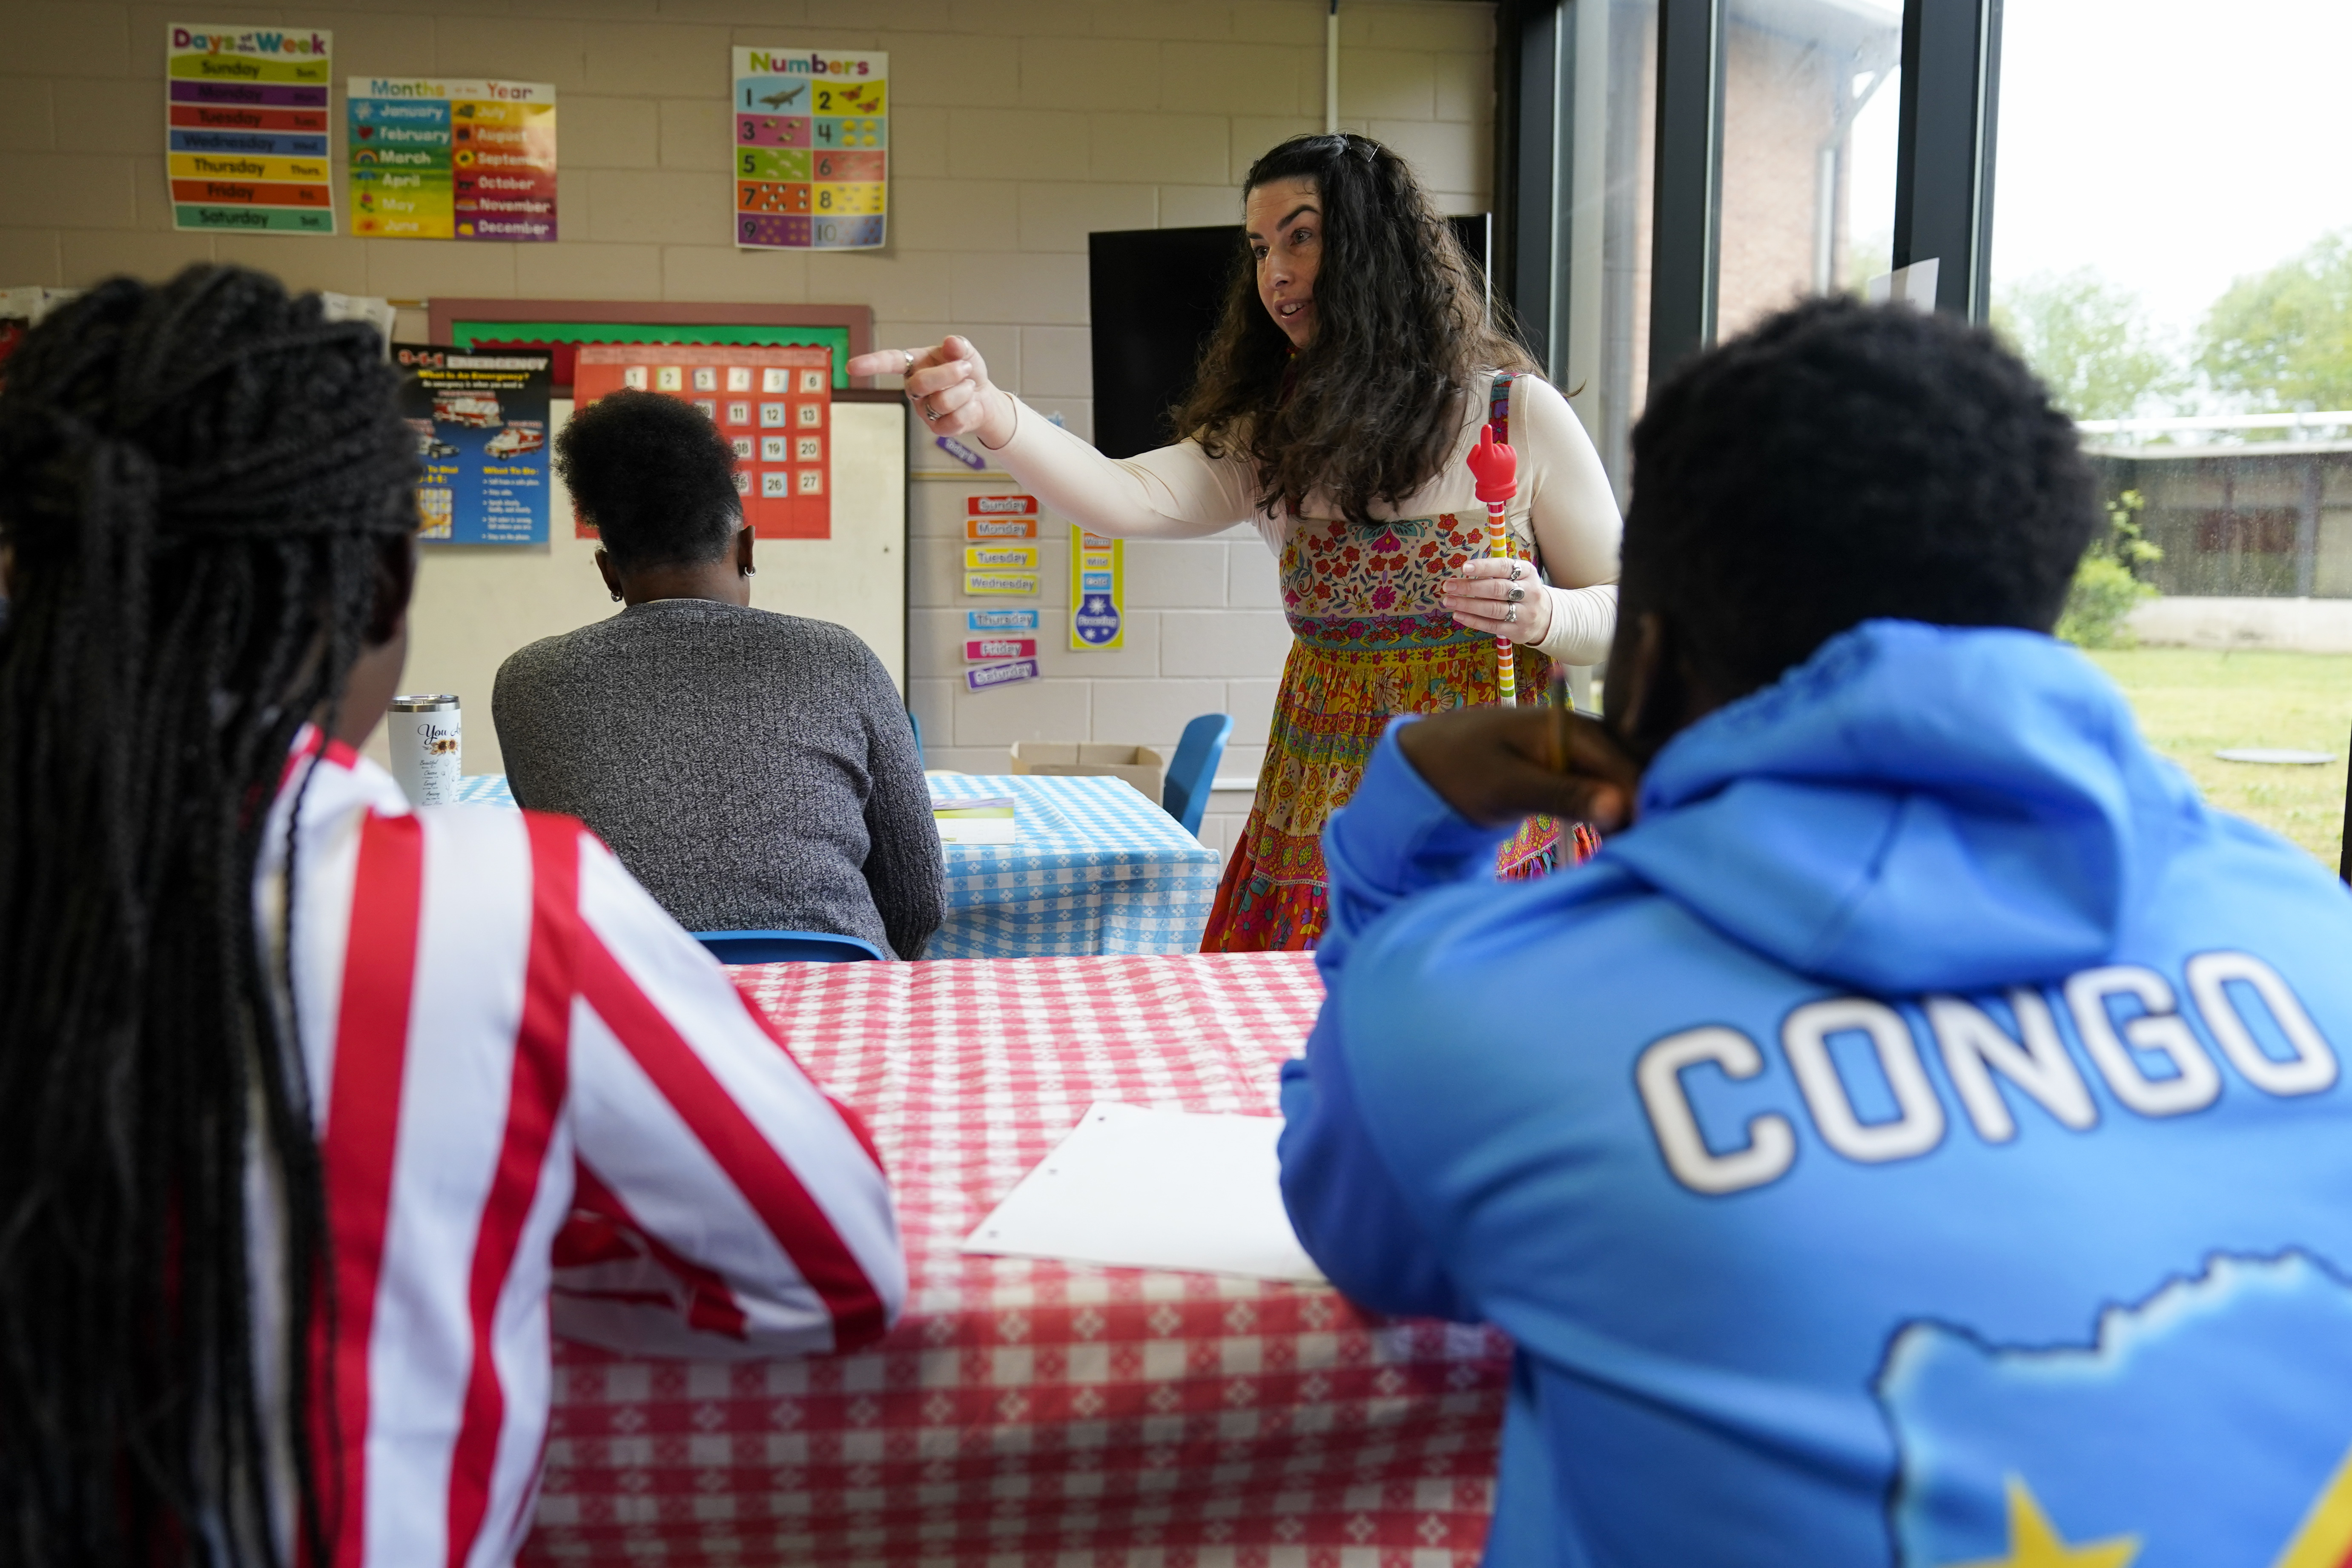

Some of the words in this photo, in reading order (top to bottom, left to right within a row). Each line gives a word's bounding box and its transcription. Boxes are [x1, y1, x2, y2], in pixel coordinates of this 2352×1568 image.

[173, 28, 235, 55] Days
[256, 32, 326, 55] Week
[201, 59, 261, 78] Sunday
[750, 52, 869, 75] Numbers
[371, 80, 445, 97] Months
[487, 83, 533, 99] Year
[746, 87, 751, 107] 1
[818, 91, 831, 110] 2
[199, 109, 262, 127] Tuesday
[381, 105, 443, 122] January
[380, 129, 450, 145] February
[743, 121, 755, 140] 3
[818, 124, 832, 143] 4
[379, 150, 431, 164] March
[743, 155, 755, 174] 5
[194, 158, 266, 178] Thursday
[819, 158, 832, 176] 6
[478, 175, 536, 190] October
[207, 183, 255, 202] Friday
[743, 188, 756, 206] 7
[820, 190, 832, 209] 8
[479, 198, 551, 213] November
[200, 209, 270, 228] Saturday
[479, 220, 549, 235] December
[744, 221, 757, 238] 9
[817, 224, 837, 241] 10
[632, 372, 637, 383] 1
[665, 372, 673, 384] 2
[700, 374, 708, 385] 3
[809, 376, 817, 387] 6
[733, 407, 743, 419] 11
[766, 409, 779, 421] 12
[803, 410, 815, 421] 13
[736, 442, 749, 454] 18
[767, 443, 780, 455] 19
[800, 443, 816, 455] 20
[767, 479, 782, 491] 26
[803, 476, 817, 488] 27
[980, 498, 1027, 513] Sunday
[978, 522, 1027, 536] Monday
[977, 551, 1027, 565] Tuesday
[971, 576, 1035, 591] Wednesday
[977, 612, 1033, 626] Thursday
[982, 643, 1021, 656] Friday
[976, 664, 1032, 682] Saturday
[418, 724, 446, 745] You
[1635, 948, 2340, 1196] CONGO
